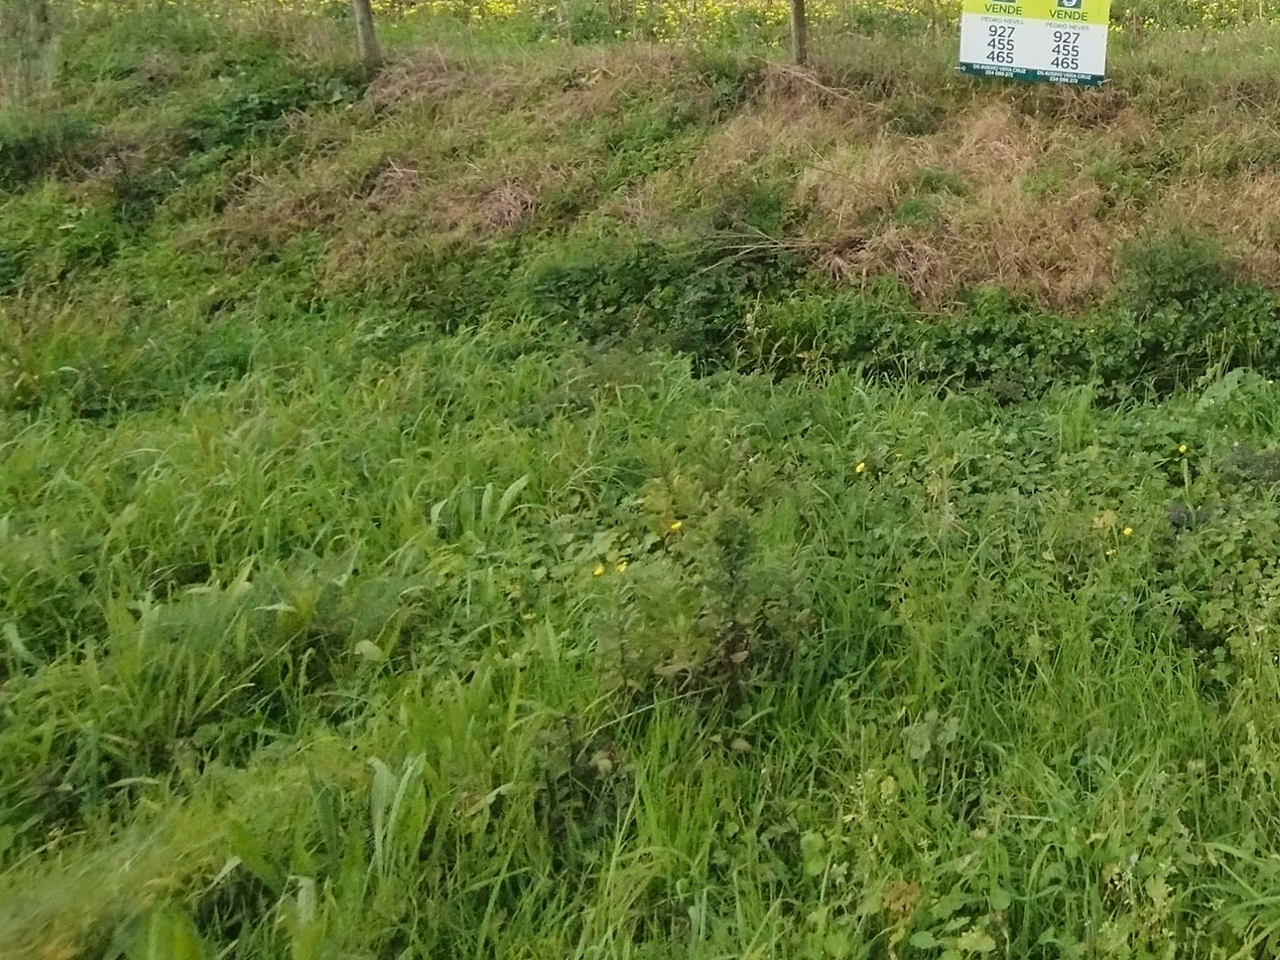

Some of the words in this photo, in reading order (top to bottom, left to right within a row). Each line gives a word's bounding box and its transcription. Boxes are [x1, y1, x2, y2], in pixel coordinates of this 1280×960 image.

[985, 3, 1022, 15] VENDE
[1049, 9, 1088, 21] VENDE
[989, 25, 1015, 38] 927
[1053, 31, 1080, 44] 927
[987, 39, 1014, 51] 455
[1052, 44, 1079, 57] 455
[986, 51, 1014, 63] 465
[1051, 57, 1079, 70] 465
